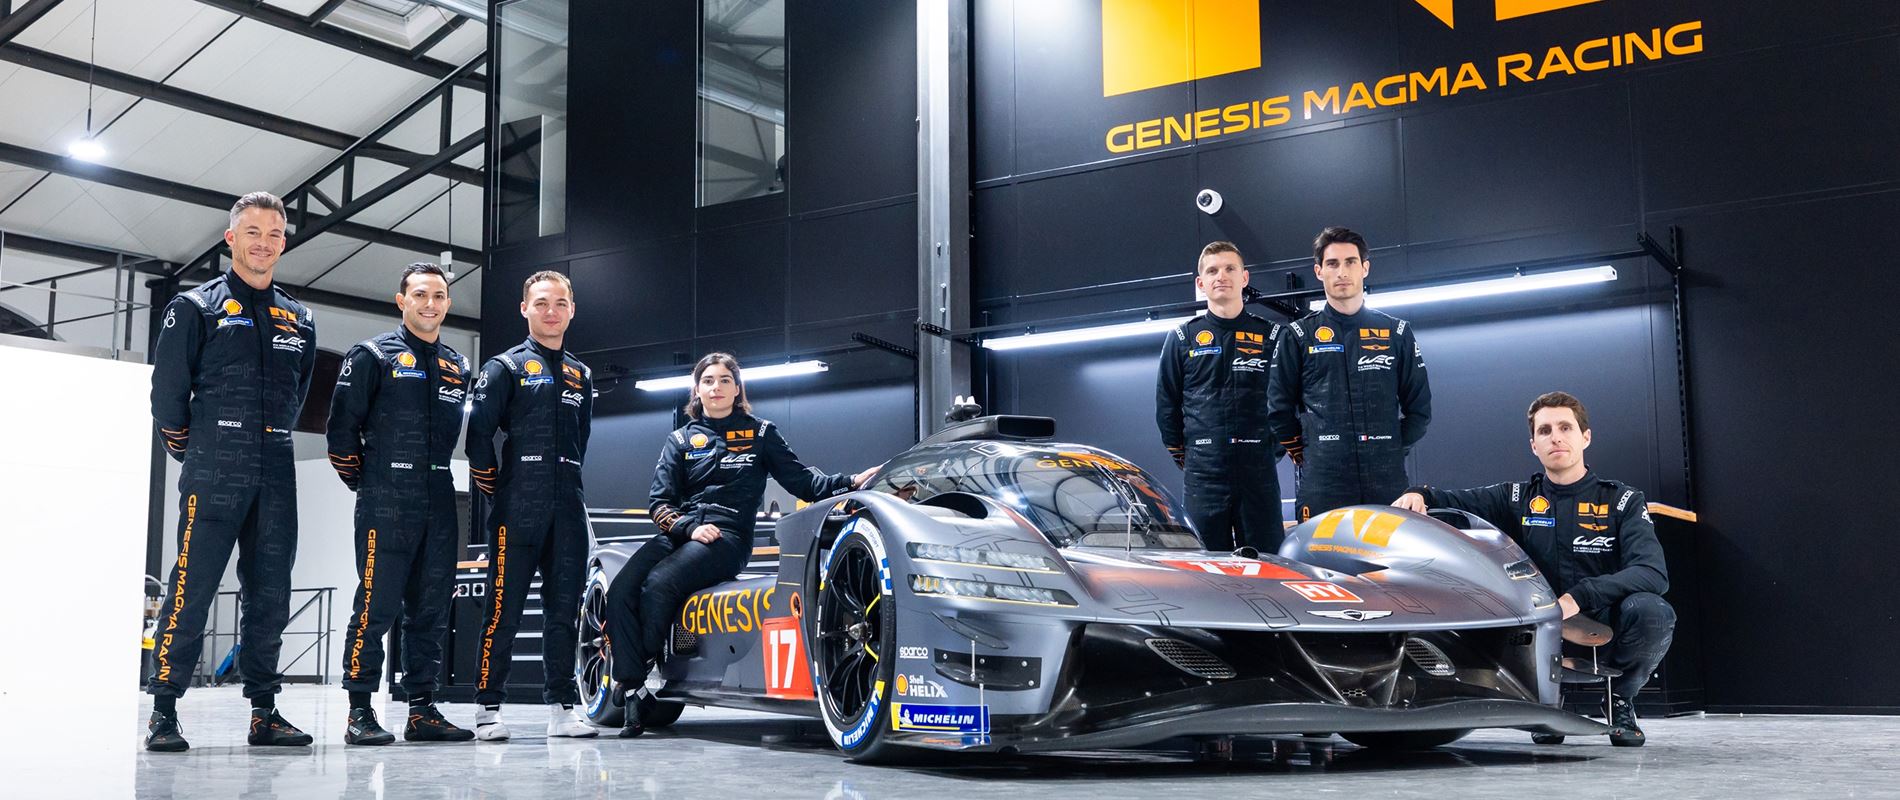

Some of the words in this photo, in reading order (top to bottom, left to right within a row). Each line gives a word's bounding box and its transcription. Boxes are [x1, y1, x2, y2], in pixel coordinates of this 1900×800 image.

[1105, 95, 1290, 154] GENESIS
[1303, 62, 1487, 120] MAGMA
[1498, 20, 1704, 86] RACING
[272, 334, 306, 349] WEC
[1232, 357, 1268, 368] WEC
[1357, 354, 1395, 366] WEC
[438, 386, 465, 399] WEC
[561, 389, 584, 403] WEC
[720, 453, 757, 463] WEC
[177, 494, 197, 568] GENESIS
[1572, 535, 1616, 547] WEC
[364, 529, 377, 590] GENESIS
[494, 525, 507, 588] GENESIS
[1291, 583, 1349, 598] HY
[167, 569, 188, 631] MAGMA
[485, 587, 504, 636] MAGMA
[158, 633, 174, 681] RAIN
[770, 629, 797, 689] 17
[900, 646, 929, 659] sparco
[478, 638, 493, 690] RACING
[909, 675, 924, 684] Shell
[909, 683, 948, 698] HELIX
[843, 708, 874, 746] MICHELIN
[913, 714, 975, 725] MICHELIN
